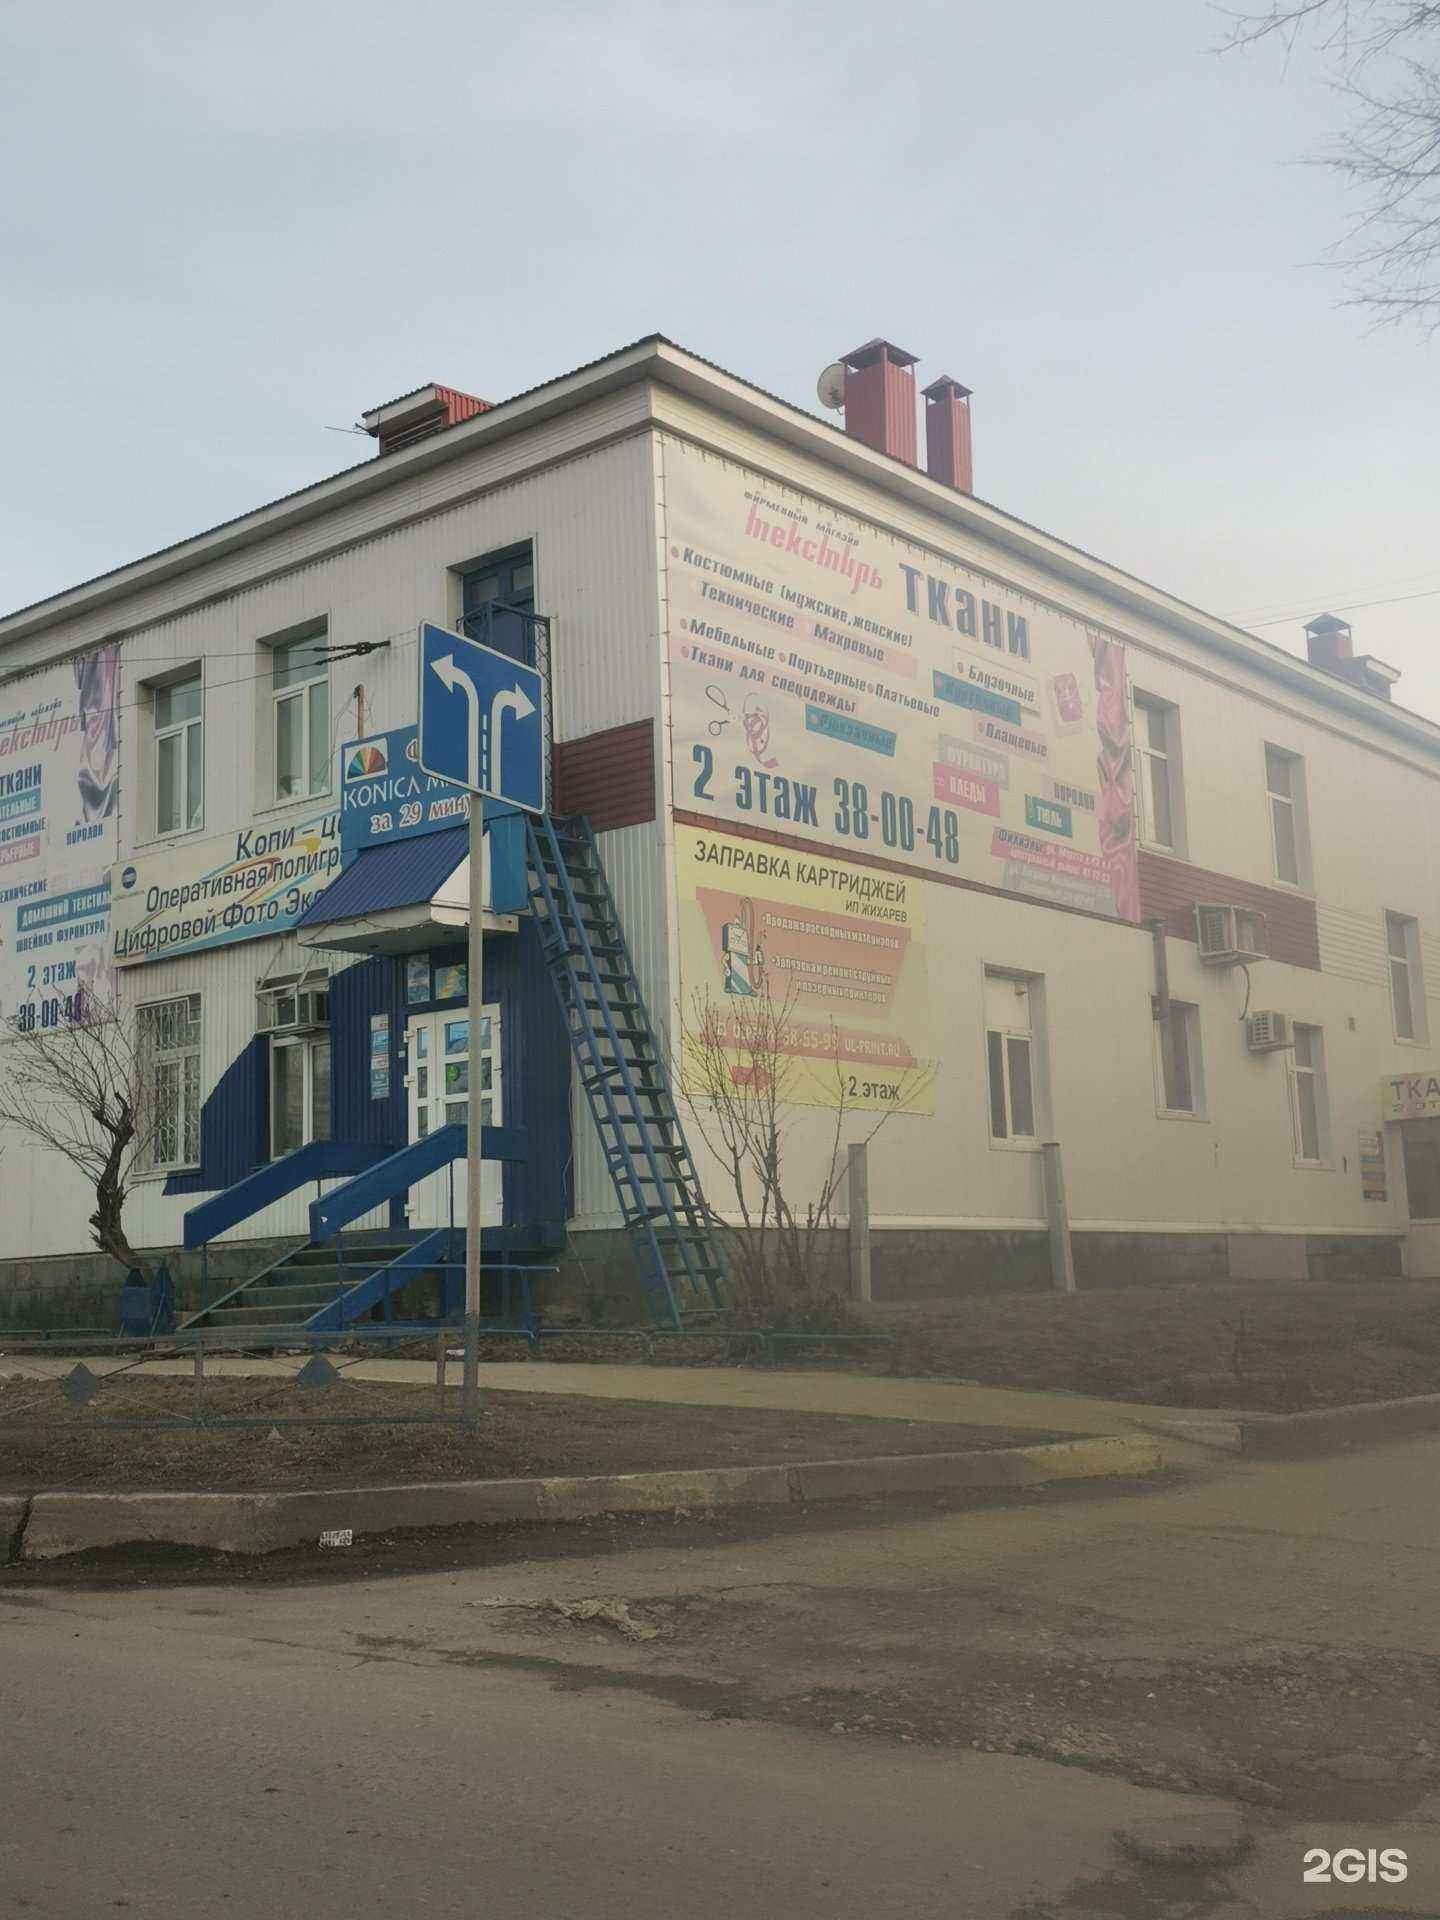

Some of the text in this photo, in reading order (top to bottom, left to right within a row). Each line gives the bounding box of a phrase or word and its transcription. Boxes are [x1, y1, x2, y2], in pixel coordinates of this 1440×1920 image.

[684, 547, 774, 594] Костюмные
[700, 582, 884, 662] Технические Махровые
[690, 619, 940, 717] Мебельные Портьерные Платьевые
[691, 646, 855, 712] Ткани для спецодежды
[968, 664, 1035, 703] Блузочные
[986, 723, 1047, 758] Плащевые
[344, 776, 420, 810] KONICA
[692, 744, 714, 801] 2
[833, 777, 959, 863] 38-00-48
[370, 813, 392, 834] за
[399, 801, 422, 827] 29
[236, 826, 295, 860] Копи
[147, 866, 268, 913] Оперативная
[694, 840, 906, 904] ЗАПРАВКА КАРТРИДЖЕЙ
[114, 908, 215, 957] Цифровой
[223, 900, 278, 930] Фото
[846, 900, 908, 923] ИП ЖИХАРЕВ
[28, 965, 36, 988] 2
[848, 1075, 899, 1100] 2 этаж
